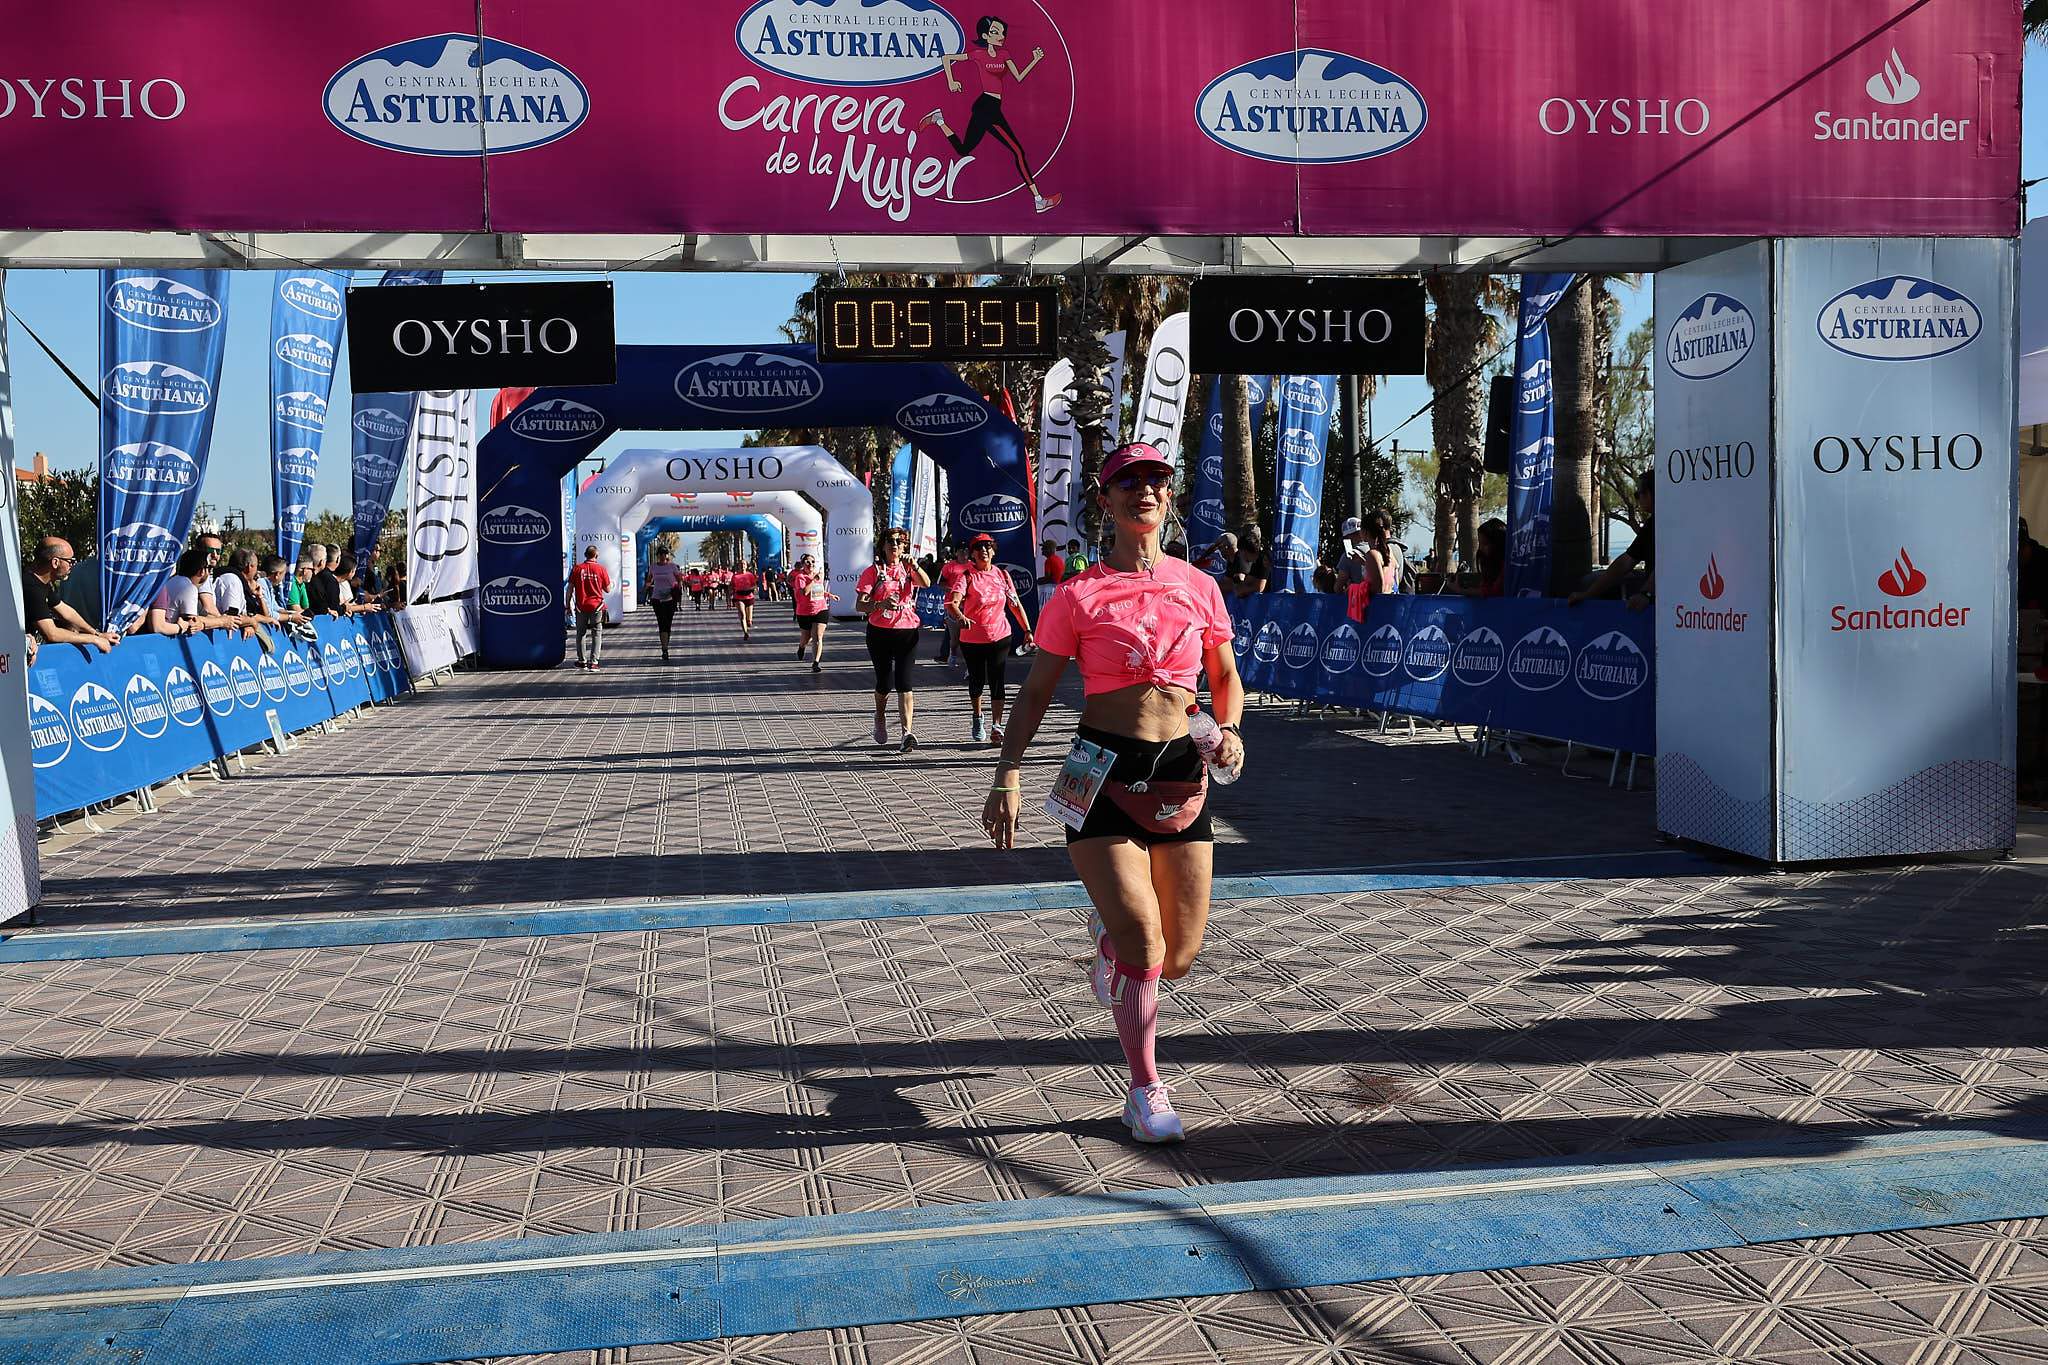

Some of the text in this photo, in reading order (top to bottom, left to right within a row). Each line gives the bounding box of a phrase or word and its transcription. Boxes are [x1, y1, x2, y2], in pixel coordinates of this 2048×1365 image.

[789, 14, 940, 26] CENTRAL LECHERA
[754, 14, 946, 59] ASTURIANA
[385, 76, 468, 88] CENTRAL
[1250, 89, 1402, 100] CENTRAL LECHERA
[345, 78, 570, 123] ASTURIANA
[718, 76, 906, 134] Carrera
[1214, 90, 1410, 133] ASTURIANA
[1538, 97, 1711, 136] OYSHO
[1814, 110, 1970, 142] Santander
[766, 130, 976, 222] de la Mujer
[112, 288, 213, 323] ASTURIANA
[286, 284, 338, 315] ASTURIAN
[1854, 305, 1965, 314] CENTRAL LECHERA
[392, 317, 578, 357] OYSHO
[834, 300, 1040, 349] 00:57:54
[1229, 308, 1393, 344] OYSHO
[1829, 307, 1970, 340] ASTURIANA
[1672, 327, 1749, 363] ASTURIANA
[111, 374, 206, 406] ASTURIANA
[687, 371, 813, 397] ASTURIANA
[516, 415, 598, 432] ASTURIANA
[904, 410, 983, 427] ASTURIANA
[1668, 441, 1755, 485] OYSHO
[1813, 433, 1983, 474] OYSHO
[666, 456, 783, 481] OYSHO
[596, 486, 632, 495] OYSHO
[817, 479, 851, 489] OYSHO
[482, 521, 547, 536] ASTURIANA
[965, 508, 1026, 525] ASTURIANA
[581, 534, 615, 542] OYSHO
[483, 590, 547, 606] ASTURIANA
[1675, 604, 1748, 632] Santander
[1831, 602, 1971, 632] Santander
[1455, 646, 1500, 671] ASTURIANA
[1511, 648, 1566, 676] ASTURIANA
[1579, 653, 1640, 686] ASTURIANA
[76, 710, 126, 738] ASTURIANA
[129, 700, 168, 725] ASTURIANA
[31, 723, 70, 750] TURIANA
